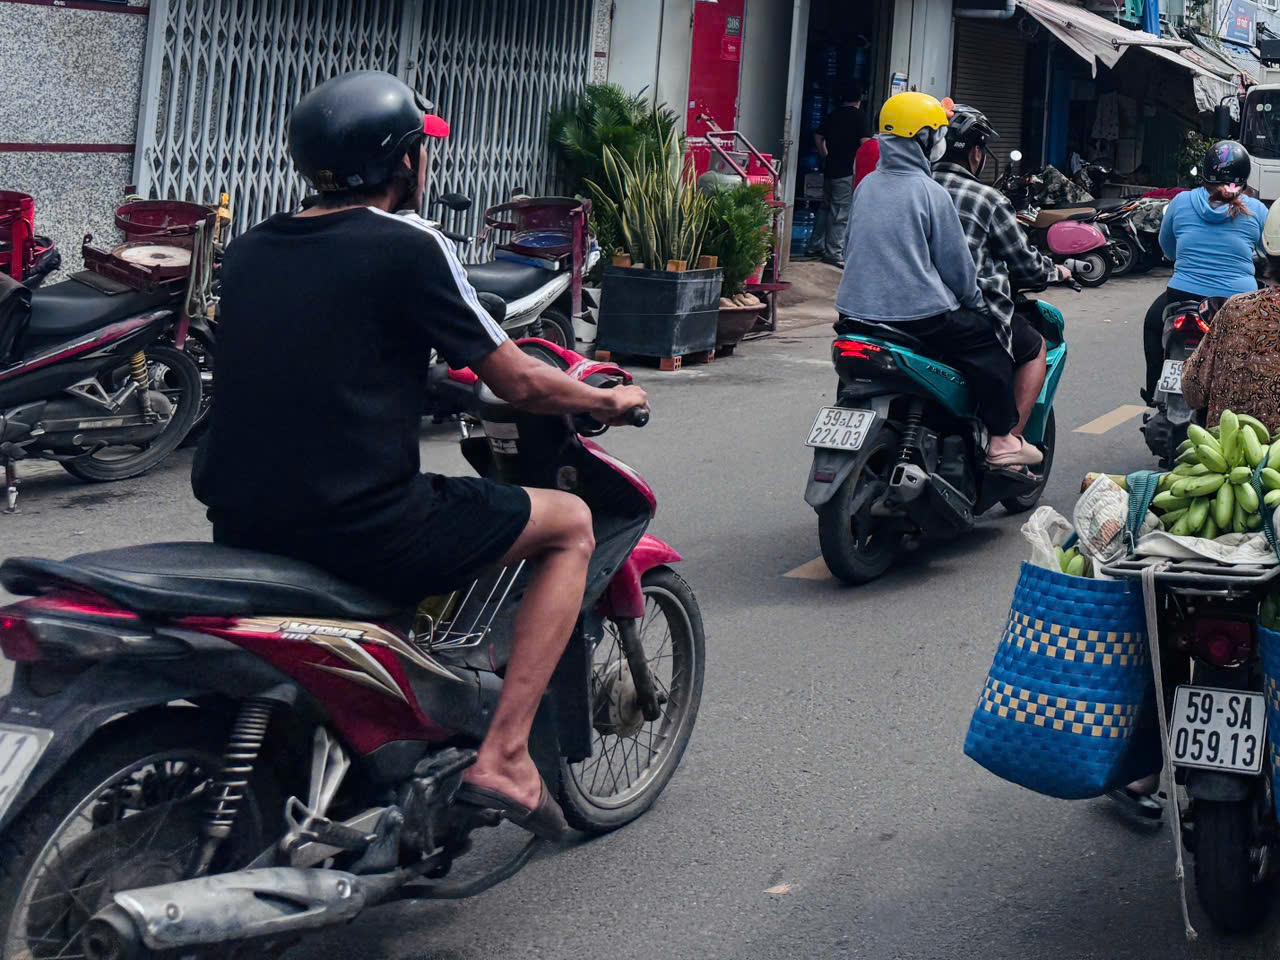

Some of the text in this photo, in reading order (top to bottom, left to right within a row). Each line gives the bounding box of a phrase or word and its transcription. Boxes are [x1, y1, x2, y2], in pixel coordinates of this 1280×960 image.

[810, 427, 862, 446] 224.03
[1186, 691, 1253, 730] 59-SA
[1175, 727, 1257, 767] 059.13
